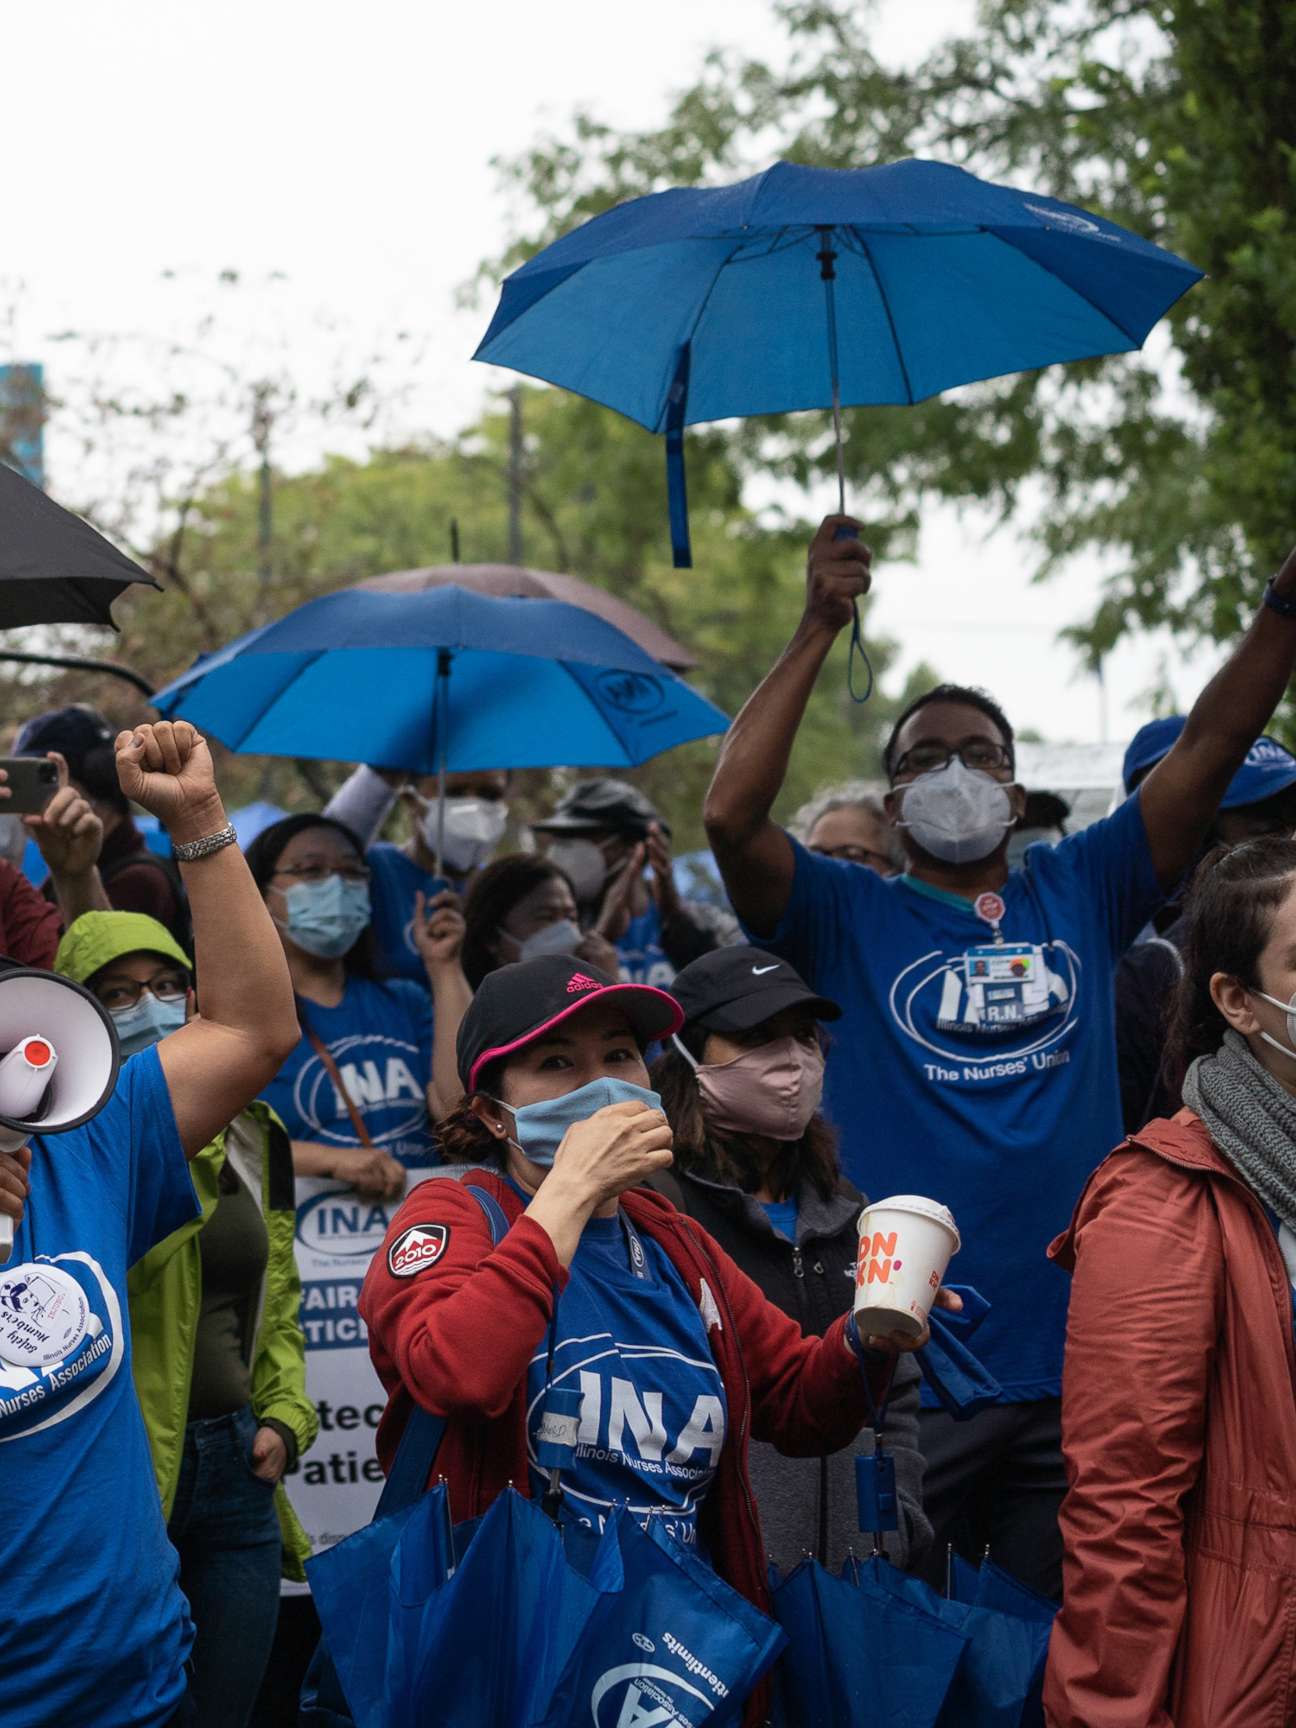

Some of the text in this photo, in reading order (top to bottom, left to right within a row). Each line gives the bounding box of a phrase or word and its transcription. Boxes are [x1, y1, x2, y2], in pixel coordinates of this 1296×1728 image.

[988, 1004, 1023, 1021] R.N.
[924, 1064, 960, 1081] The
[317, 1204, 389, 1235] INA
[395, 1244, 437, 1270] 2010
[48, 1333, 112, 1392] Association
[576, 1370, 724, 1466] INA
[622, 1453, 664, 1475] Nurses
[634, 1678, 680, 1716] Association
